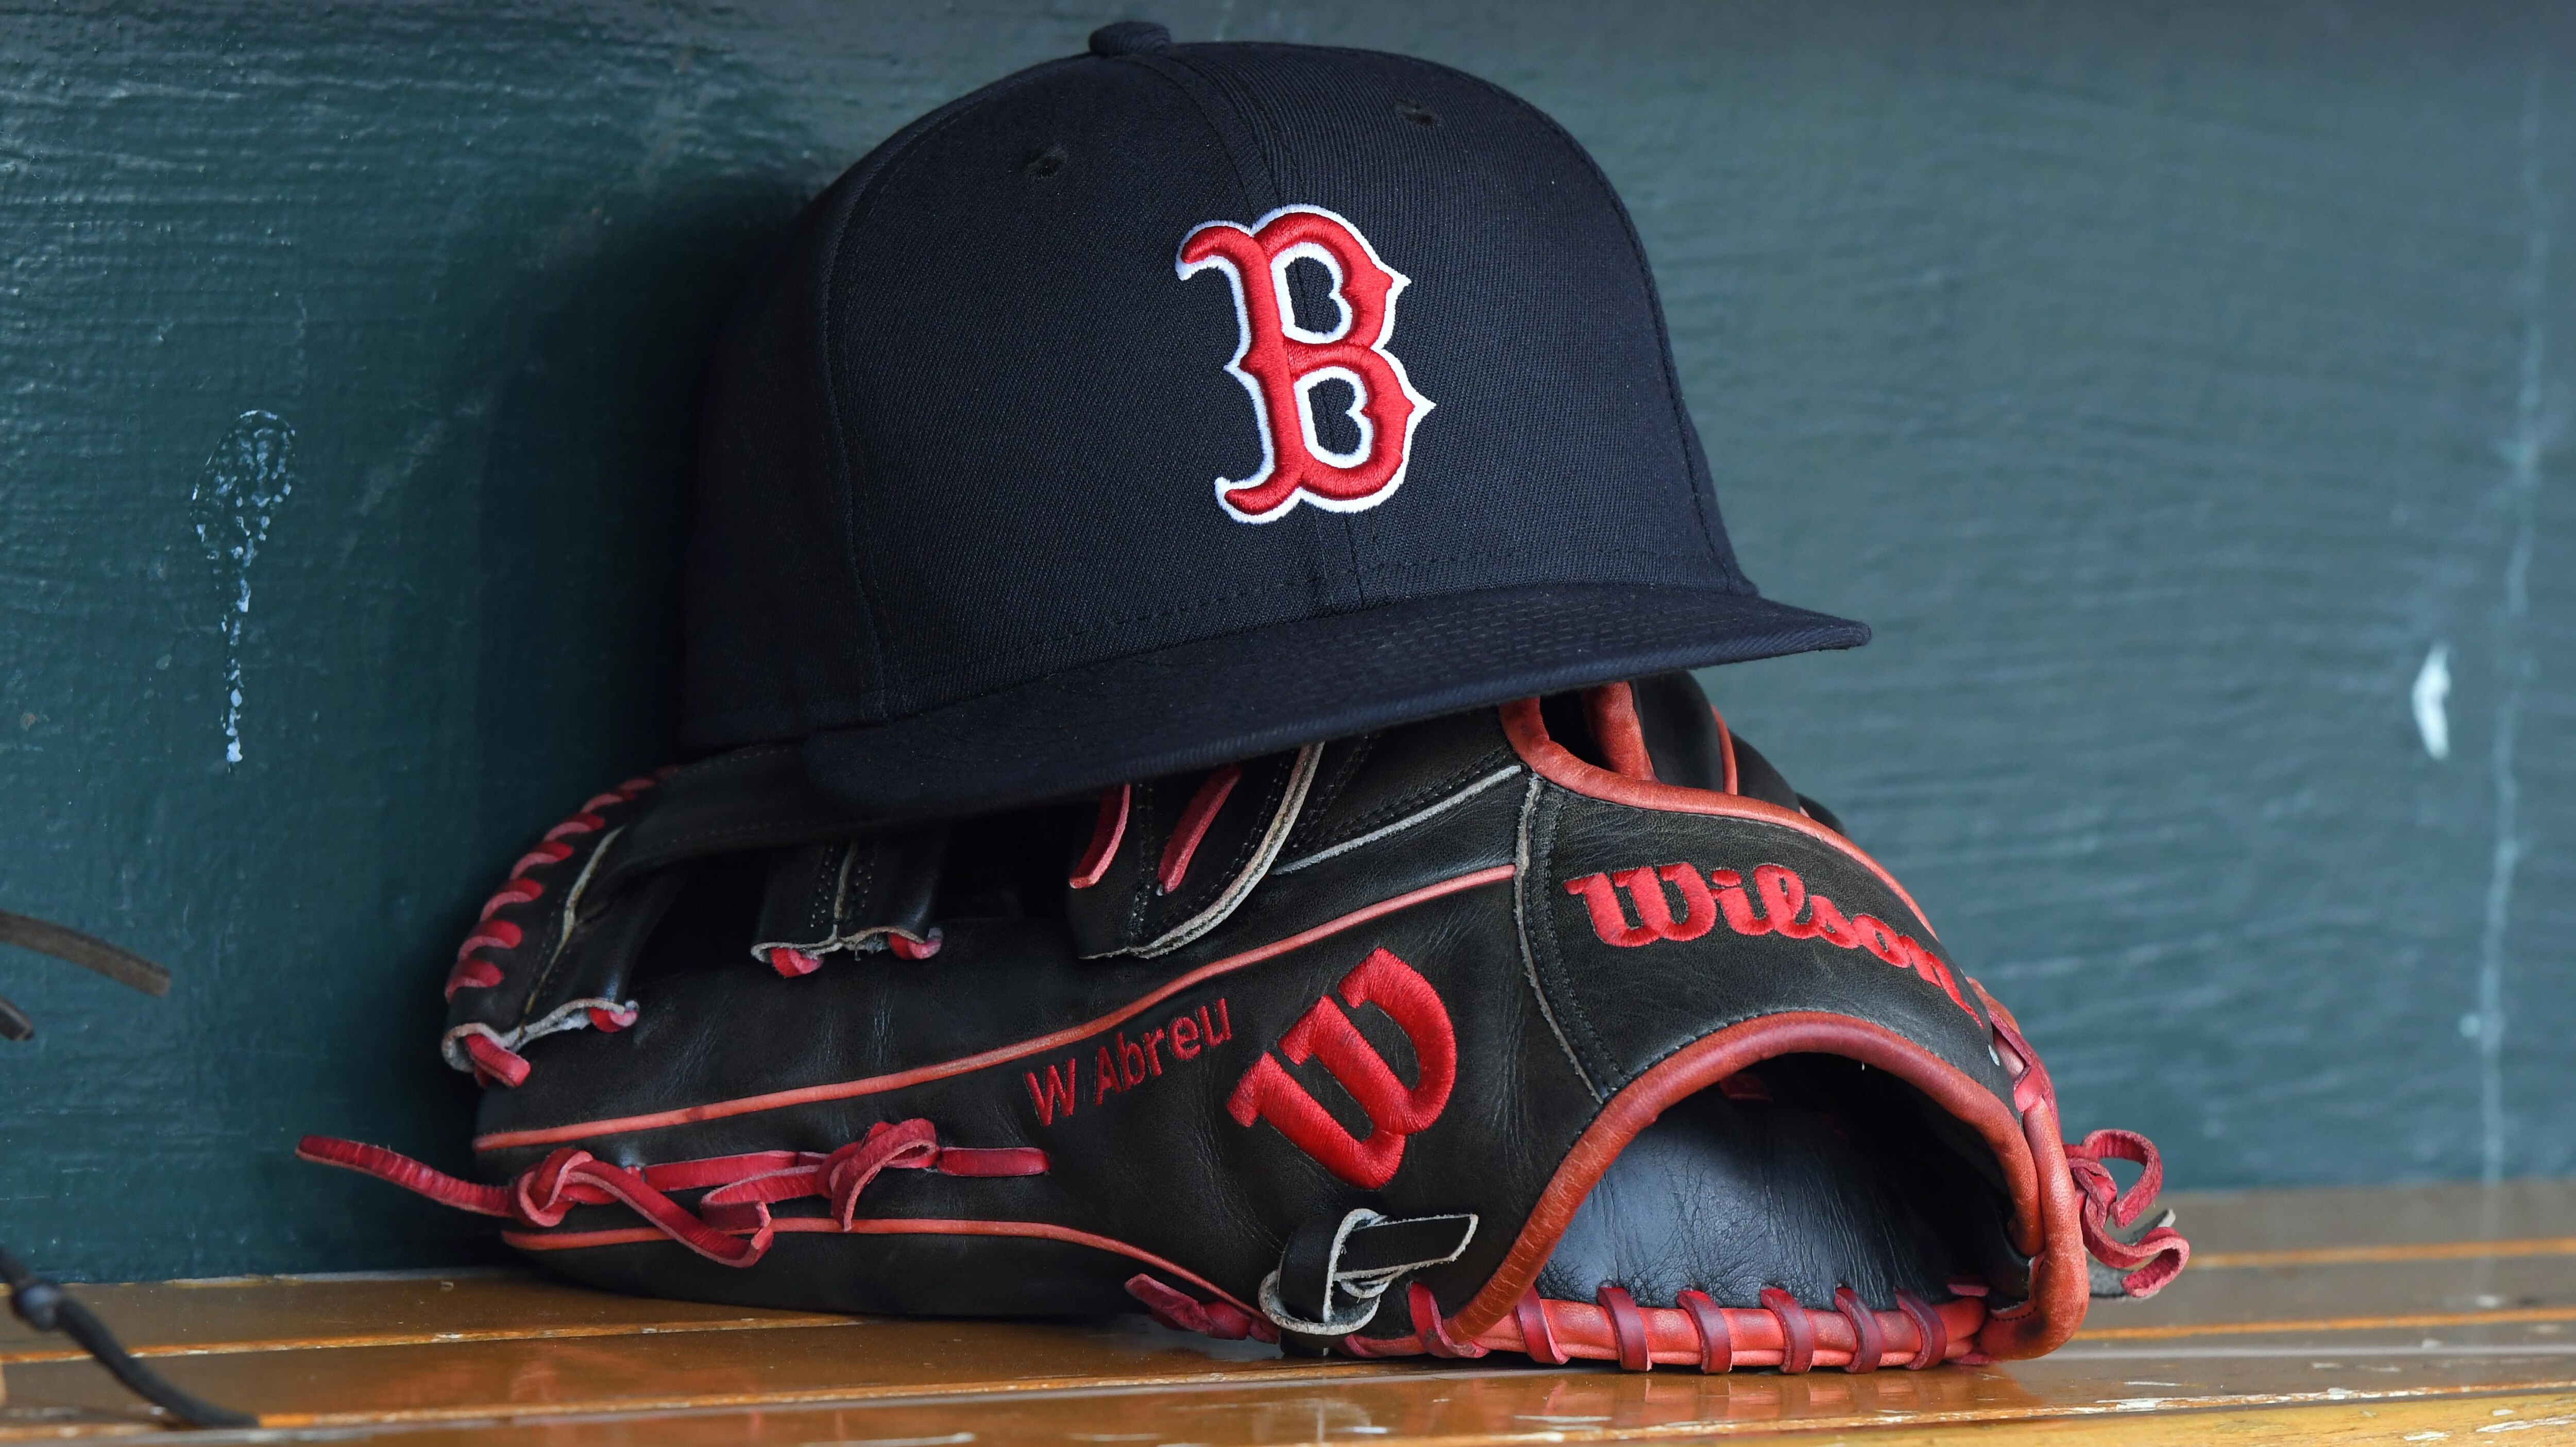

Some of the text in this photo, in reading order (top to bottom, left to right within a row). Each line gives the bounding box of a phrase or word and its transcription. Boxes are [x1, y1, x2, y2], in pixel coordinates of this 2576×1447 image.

[1175, 204, 1436, 524] B
[1563, 862, 1984, 1029] Wilson
[1024, 998, 1232, 1127] W Abreu
[1226, 947, 1457, 1191] W
